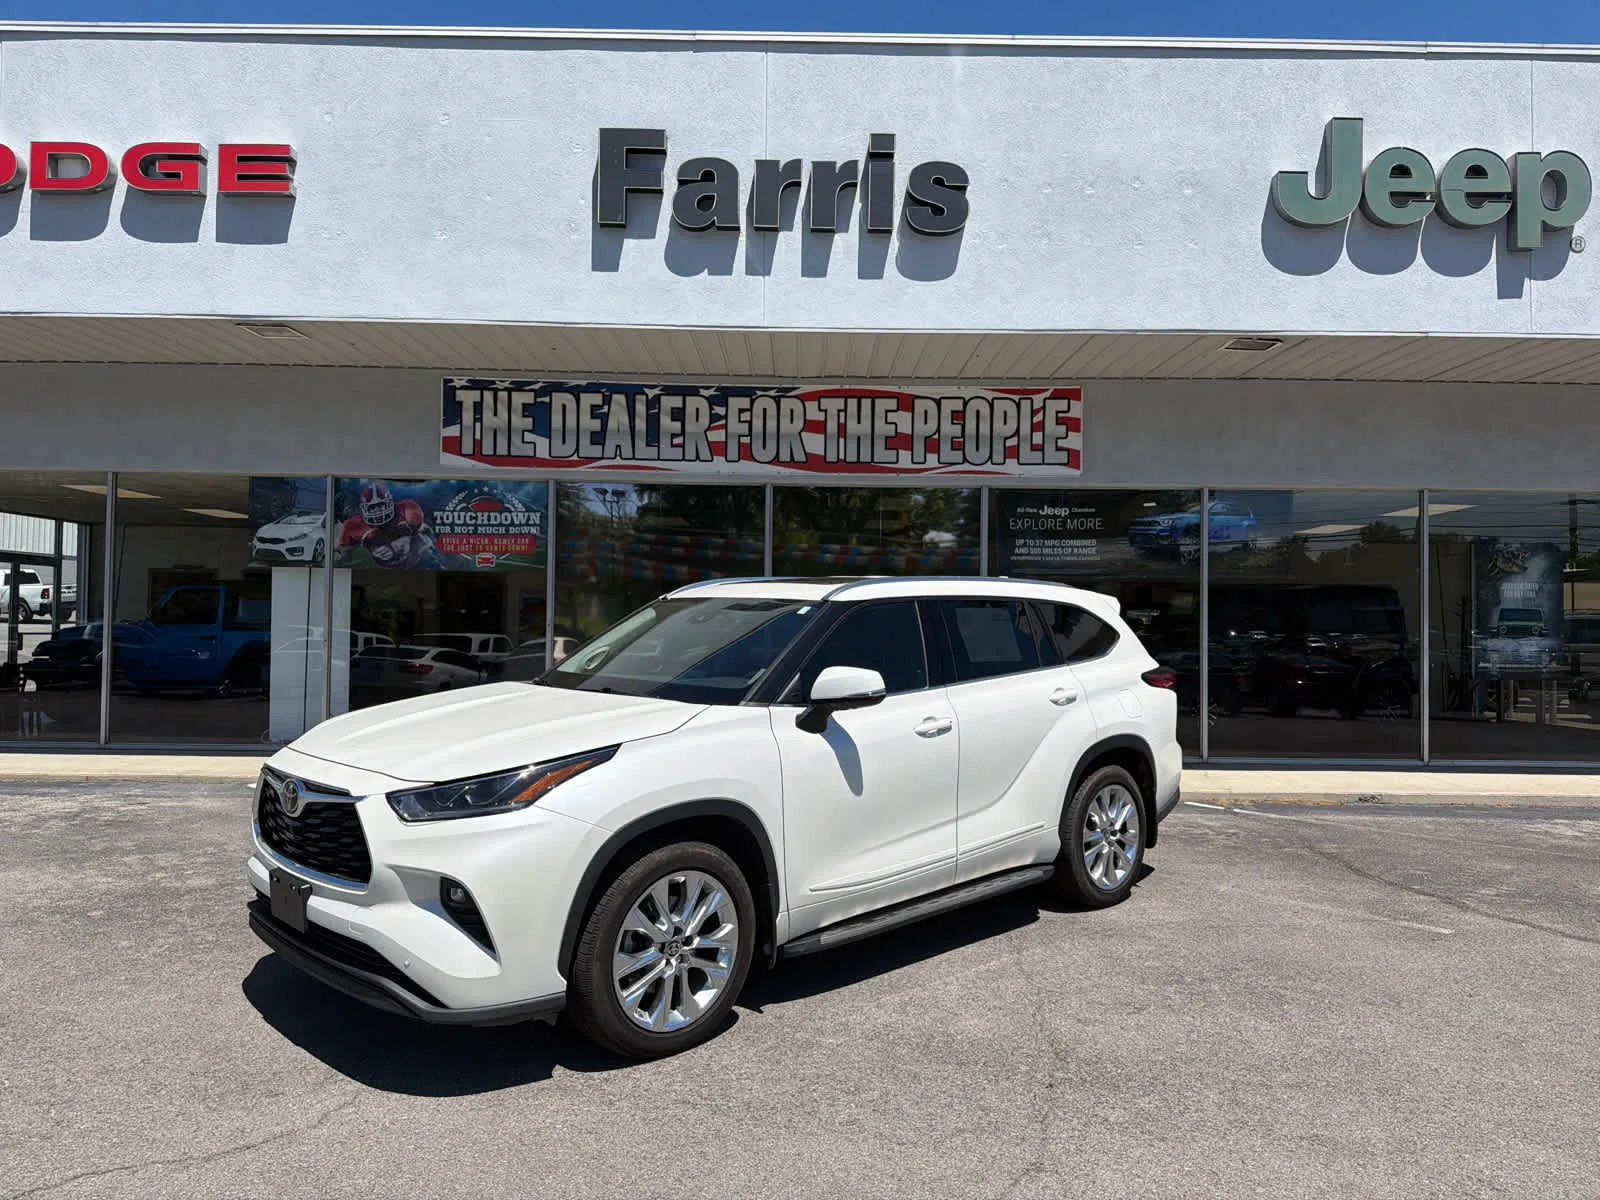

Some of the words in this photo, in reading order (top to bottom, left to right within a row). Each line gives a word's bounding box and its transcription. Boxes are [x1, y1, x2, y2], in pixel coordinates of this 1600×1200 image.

[0, 142, 296, 198] DGE
[597, 127, 970, 236] Farris
[1271, 117, 1593, 251] Jeep
[455, 389, 537, 458] THE
[549, 391, 713, 462] DEALER
[725, 395, 807, 464] FOR
[818, 397, 899, 464] THE
[911, 397, 1070, 465] PEOPLE
[433, 511, 541, 525] TOUCHDOWN
[1009, 518, 1063, 530] EXPLORE
[1066, 518, 1105, 530] MORE
[1039, 505, 1070, 517] Jeep
[454, 526, 475, 534] NOT
[477, 526, 506, 534] MUCH
